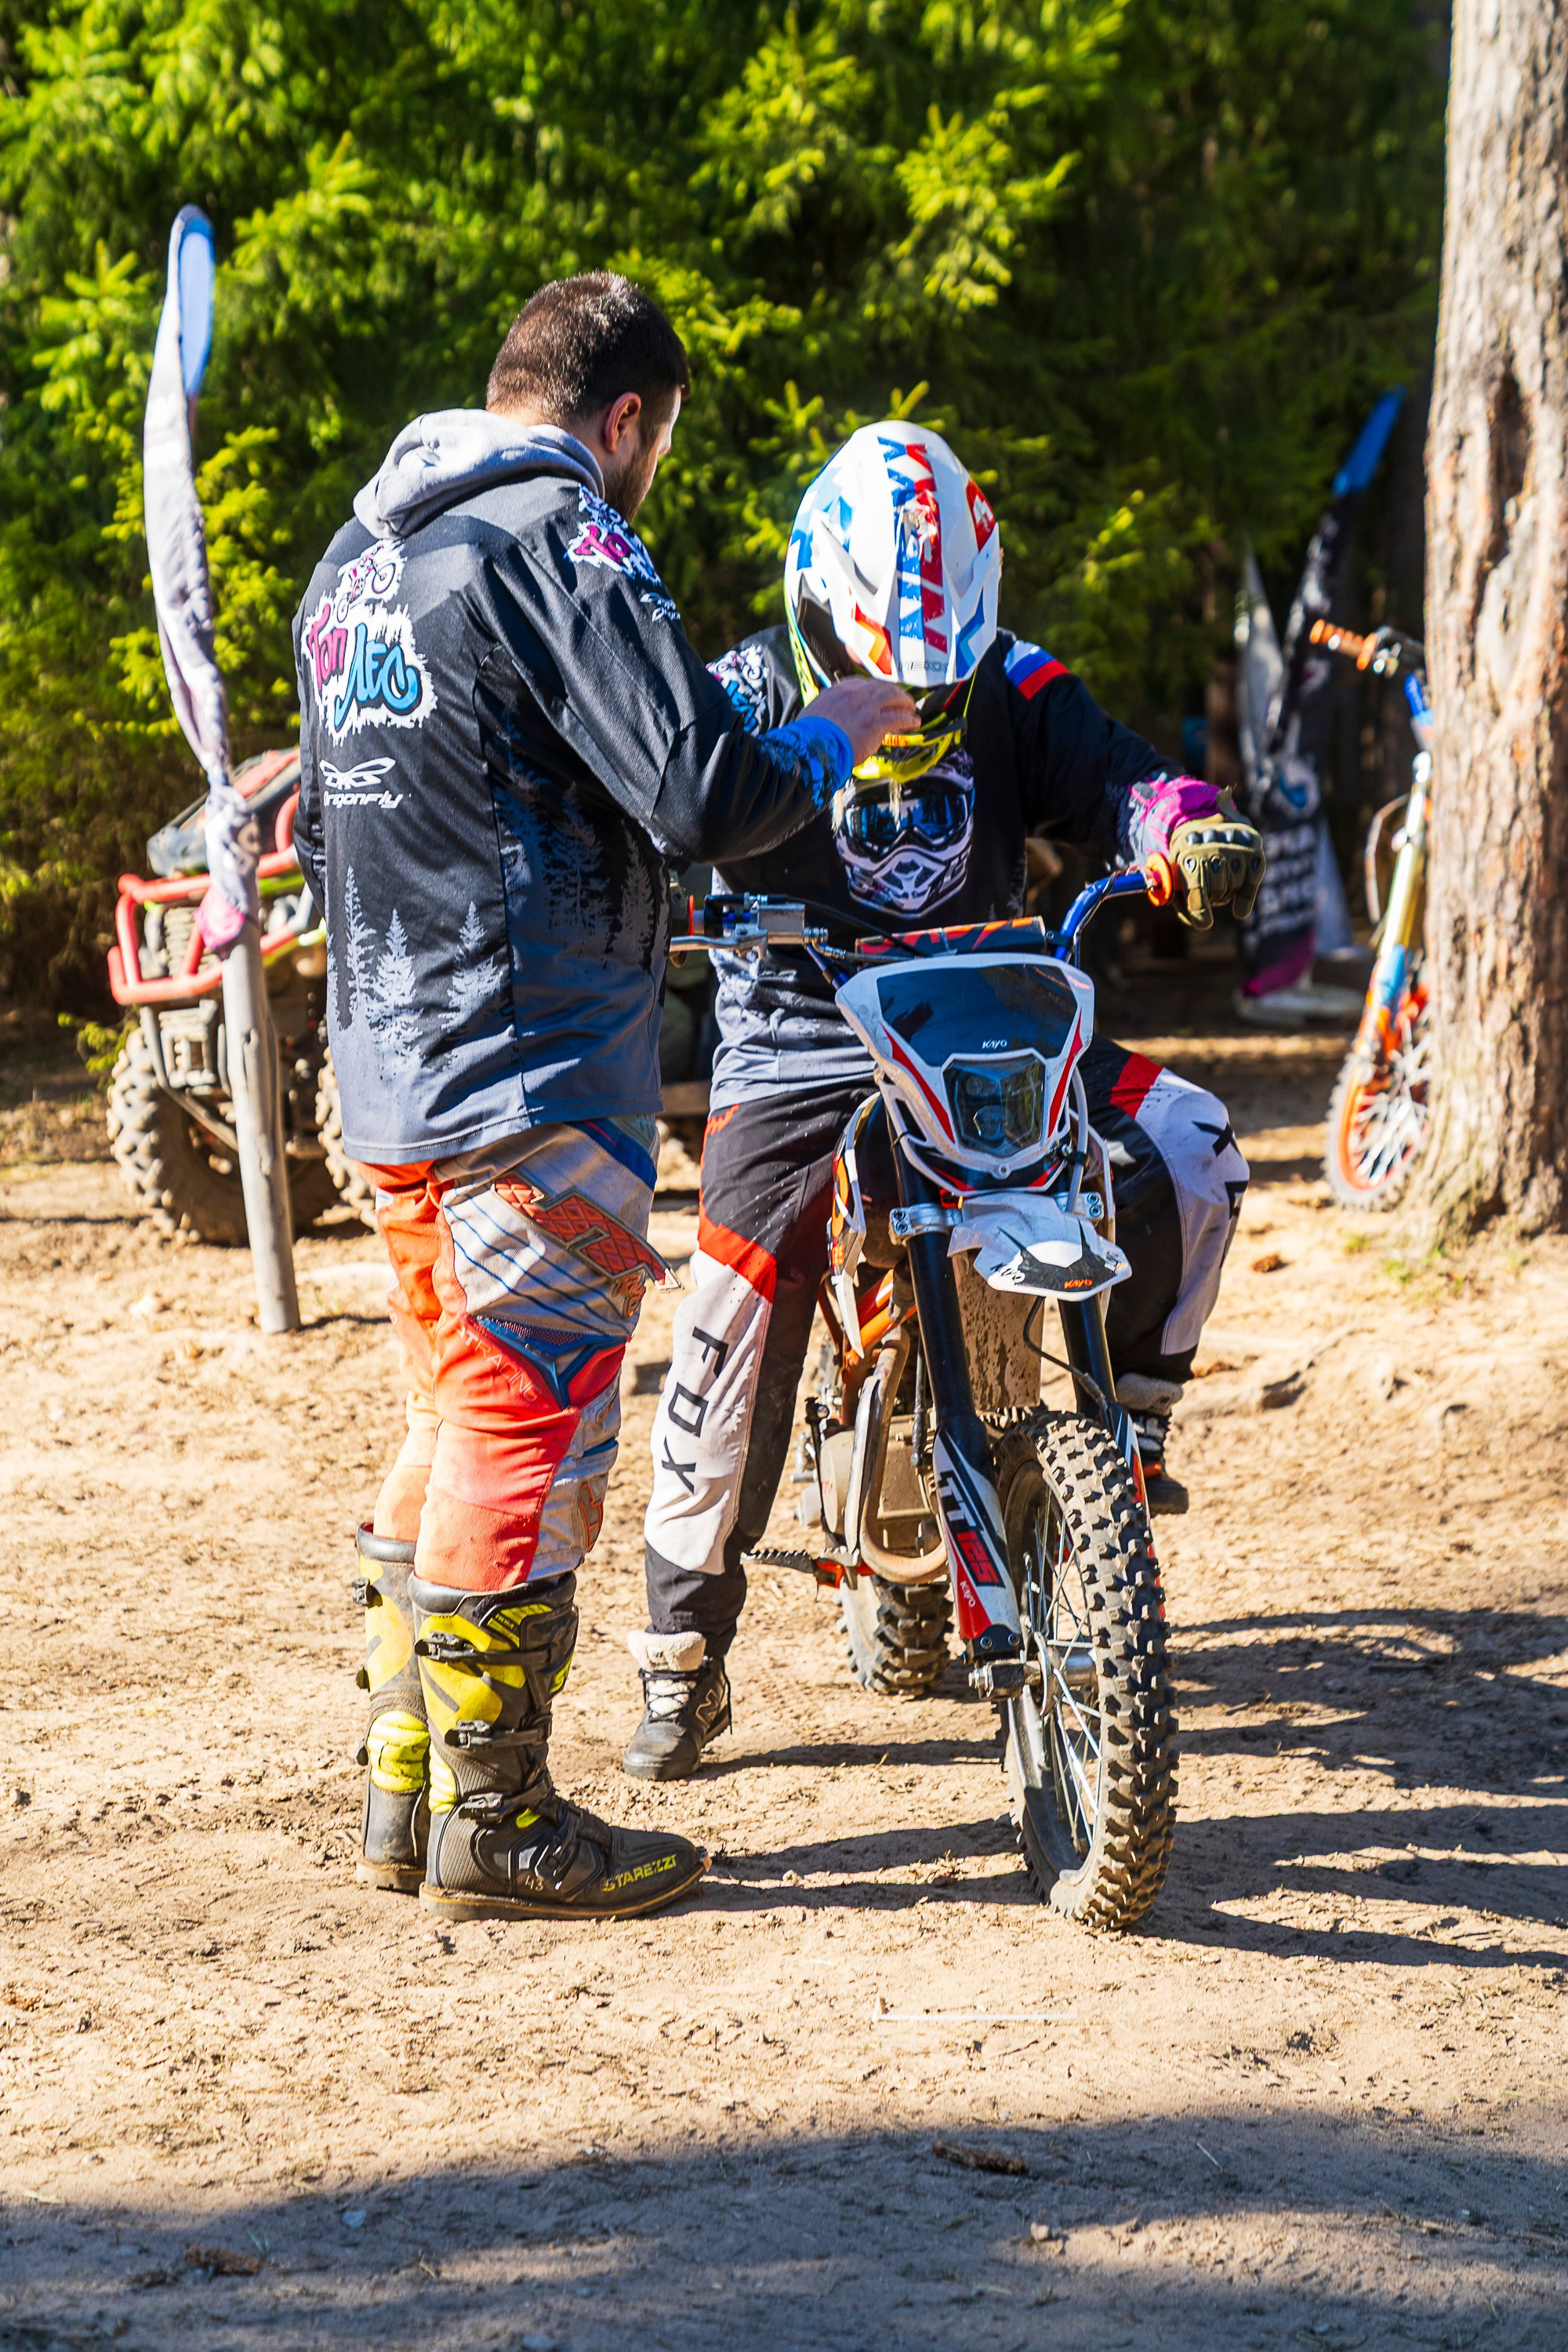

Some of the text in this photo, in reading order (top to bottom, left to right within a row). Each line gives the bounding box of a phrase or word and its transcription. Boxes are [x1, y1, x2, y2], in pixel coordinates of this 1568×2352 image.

[1063, 1279, 1093, 1289] KAYO
[661, 1326, 729, 1494] FOX
[601, 1853, 677, 1893] STAREZZI
